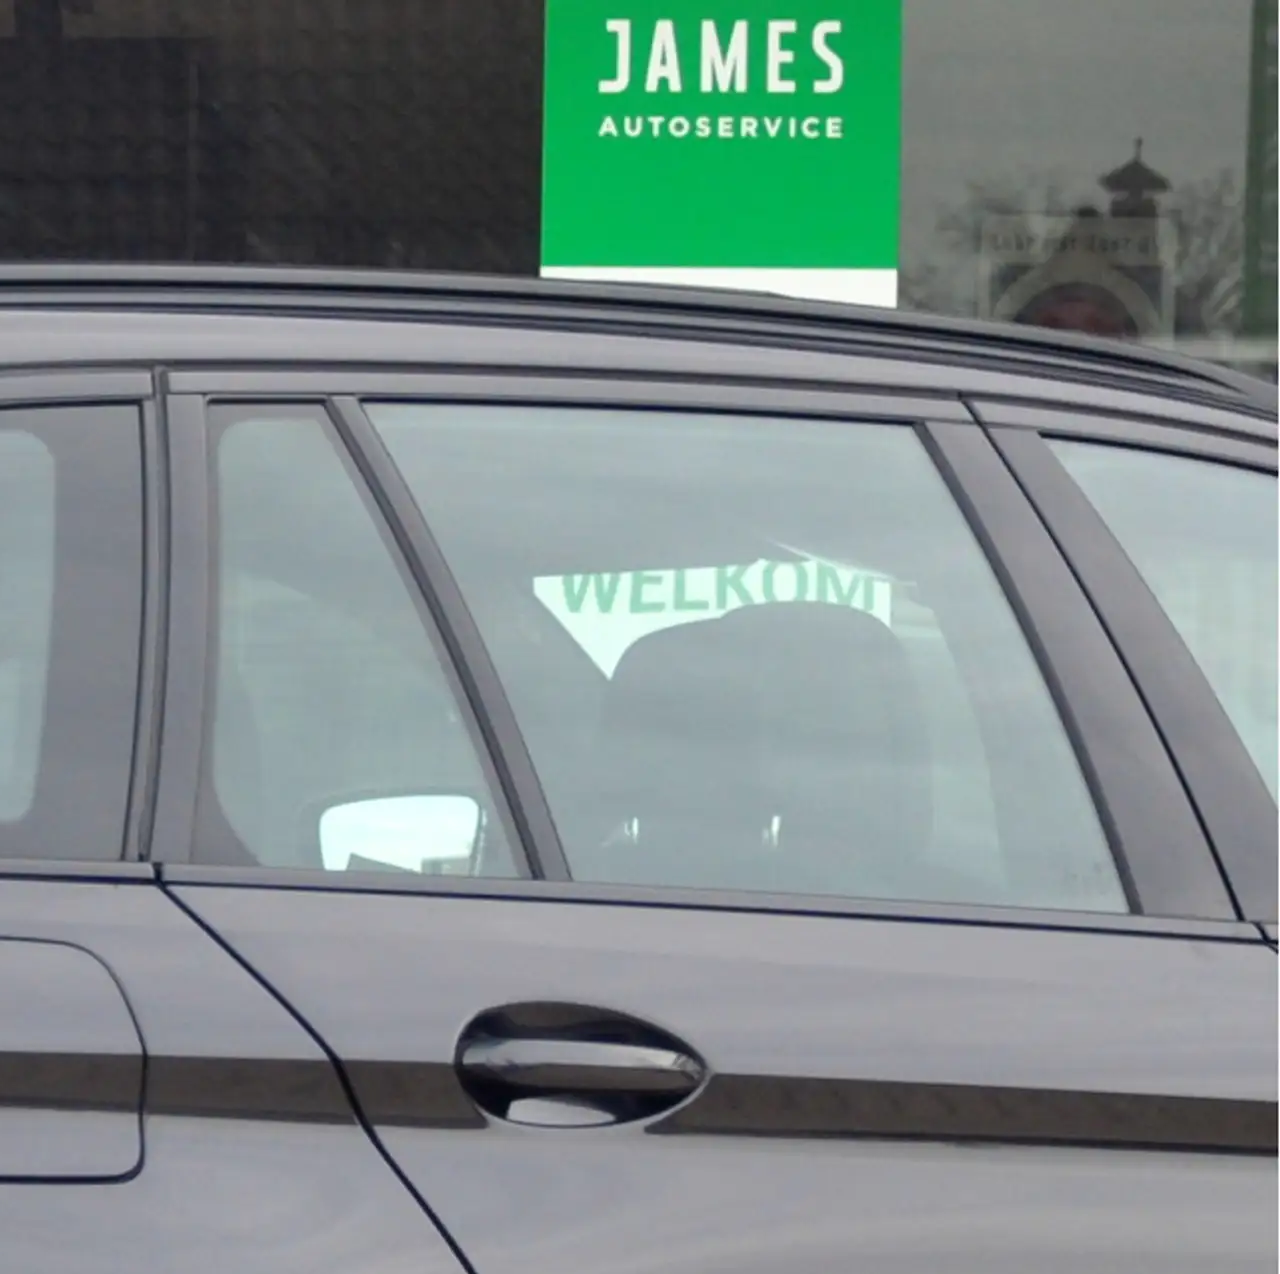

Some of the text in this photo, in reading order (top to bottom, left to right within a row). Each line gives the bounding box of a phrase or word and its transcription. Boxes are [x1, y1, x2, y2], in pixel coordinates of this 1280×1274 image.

[598, 19, 844, 94] JAMES
[598, 116, 844, 139] AUTOSERVICE
[562, 560, 877, 613] WELKOM
